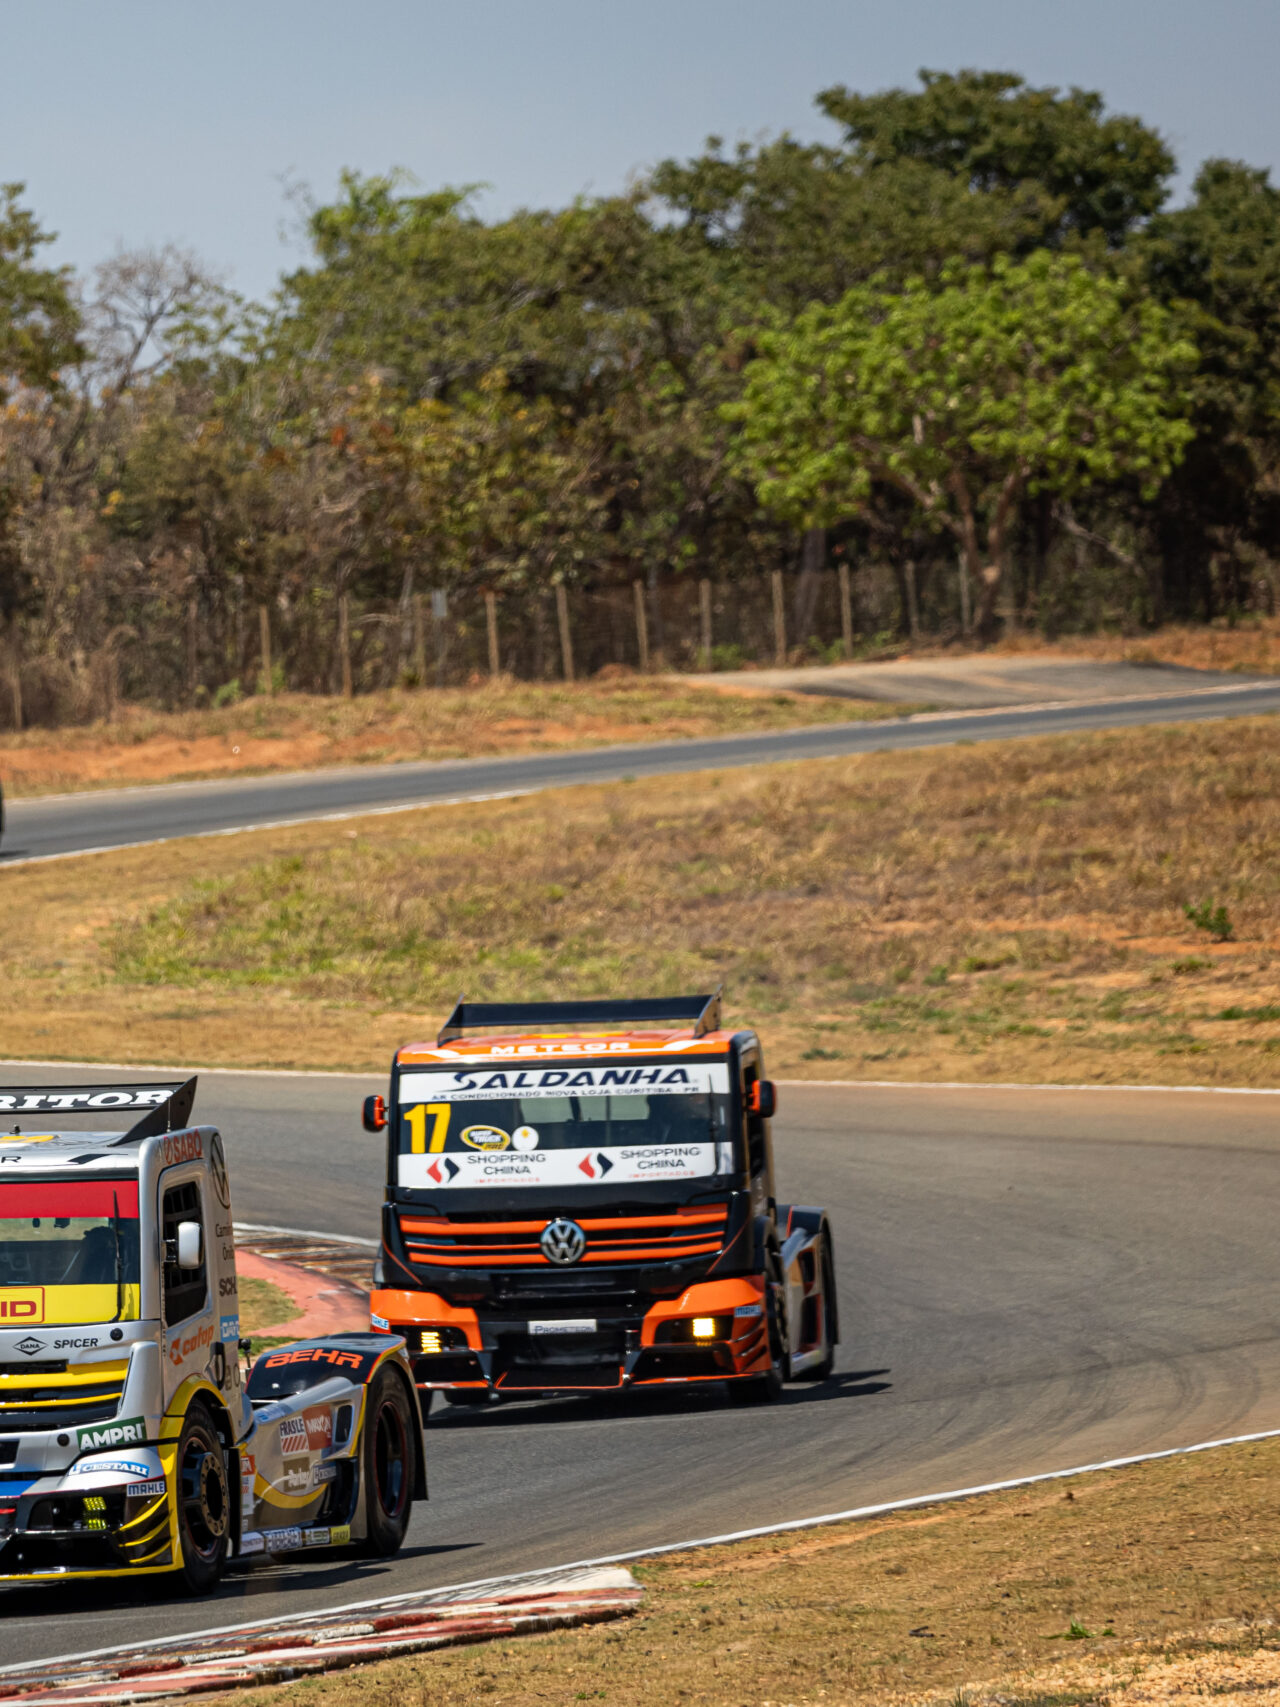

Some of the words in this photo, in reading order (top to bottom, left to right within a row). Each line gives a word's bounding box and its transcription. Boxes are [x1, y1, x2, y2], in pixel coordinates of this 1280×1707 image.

[491, 1042, 631, 1055] METEOR
[442, 1067, 690, 1092] SALDANHA
[403, 1103, 451, 1154] 17
[473, 1135, 502, 1143] TRUCK
[467, 1153, 546, 1164] SHOPPING
[620, 1146, 701, 1160] SHOPPING
[483, 1165, 531, 1175] CHINA
[637, 1159, 686, 1170] CHINA
[53, 1337, 98, 1349] SPICER
[182, 1325, 215, 1356] cofap
[265, 1349, 364, 1369] BEHR
[80, 1422, 143, 1451] AMPRI
[82, 1462, 148, 1476] CESTARI
[128, 1482, 165, 1495] MAHLE
